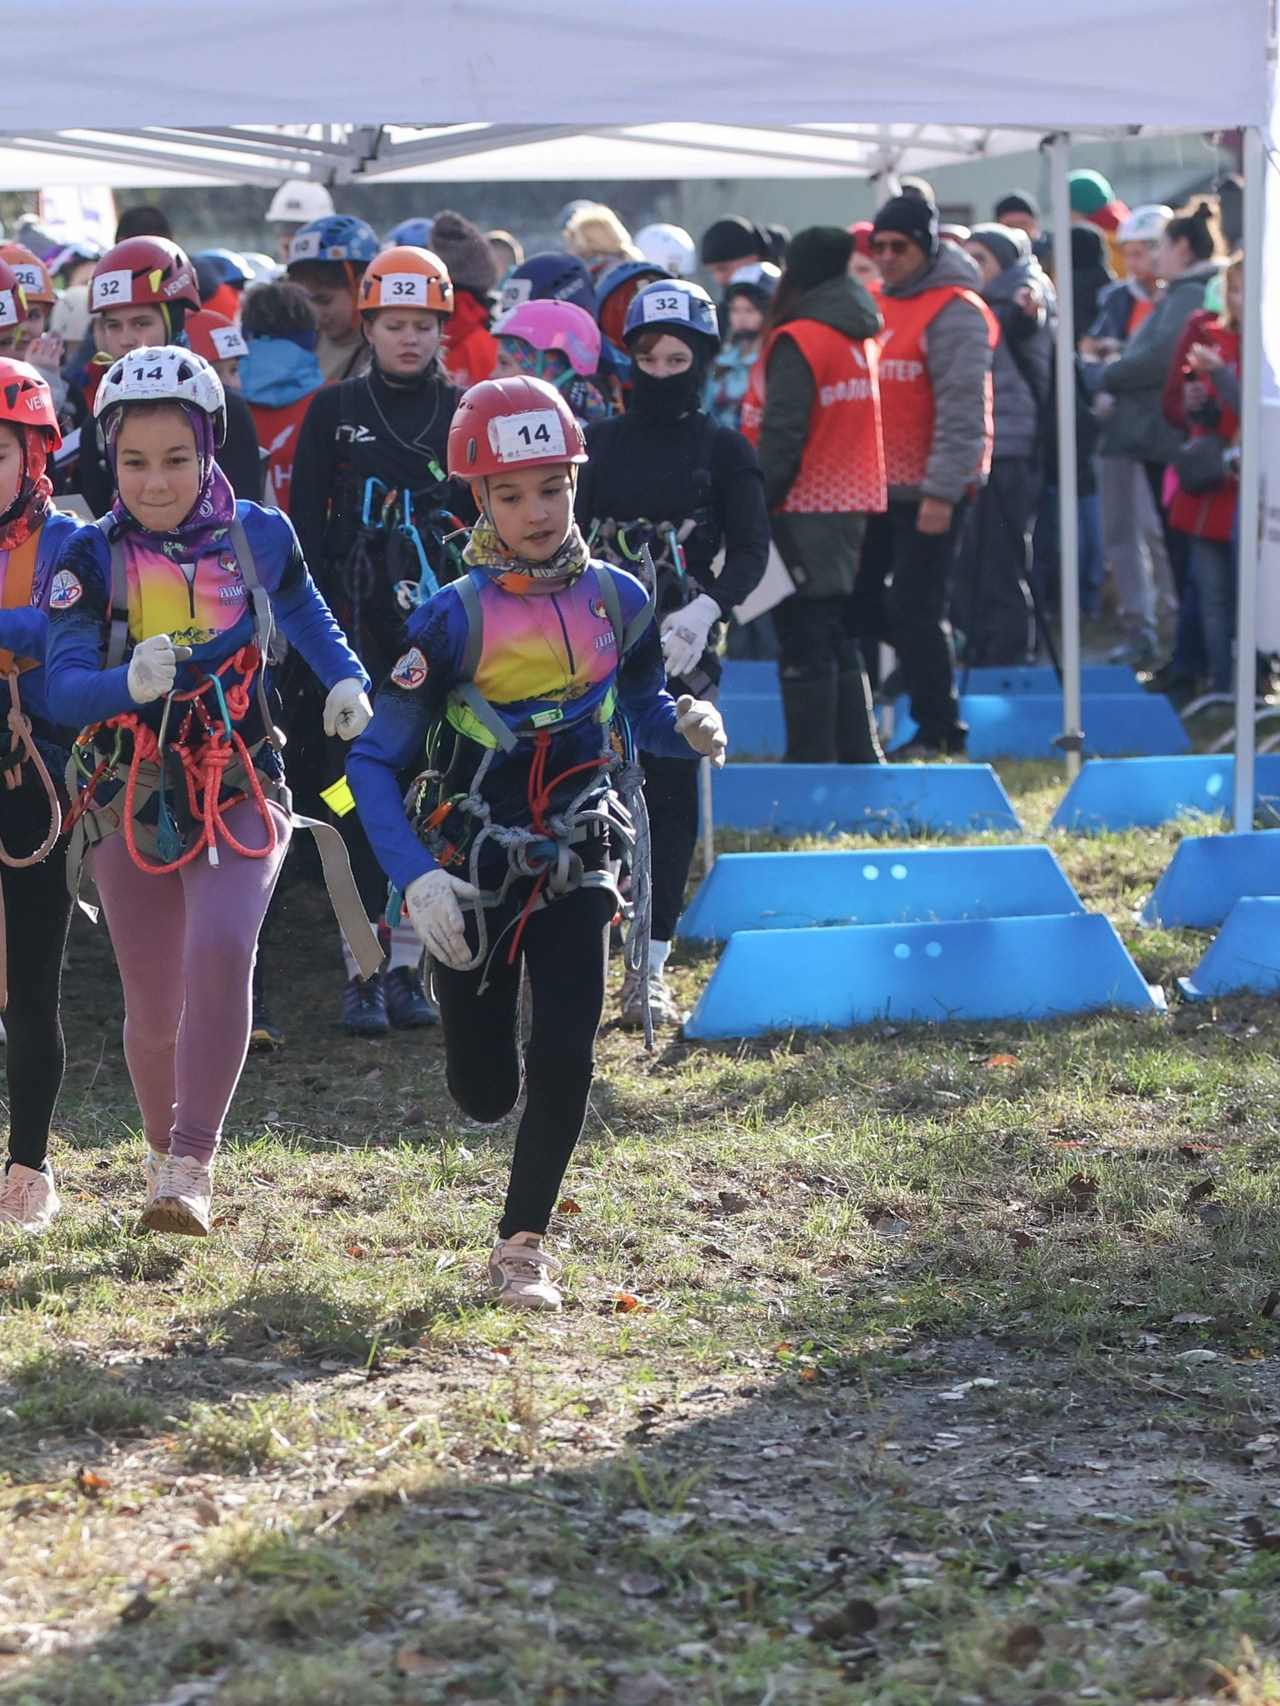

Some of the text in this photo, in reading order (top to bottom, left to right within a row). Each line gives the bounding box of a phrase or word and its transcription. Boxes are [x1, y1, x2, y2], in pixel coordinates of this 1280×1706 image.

[16, 271, 35, 285] 26
[100, 280, 120, 297] 32
[392, 281, 416, 296] 32
[655, 297, 679, 311] 32
[132, 366, 163, 381] 14
[517, 423, 551, 445] 14
